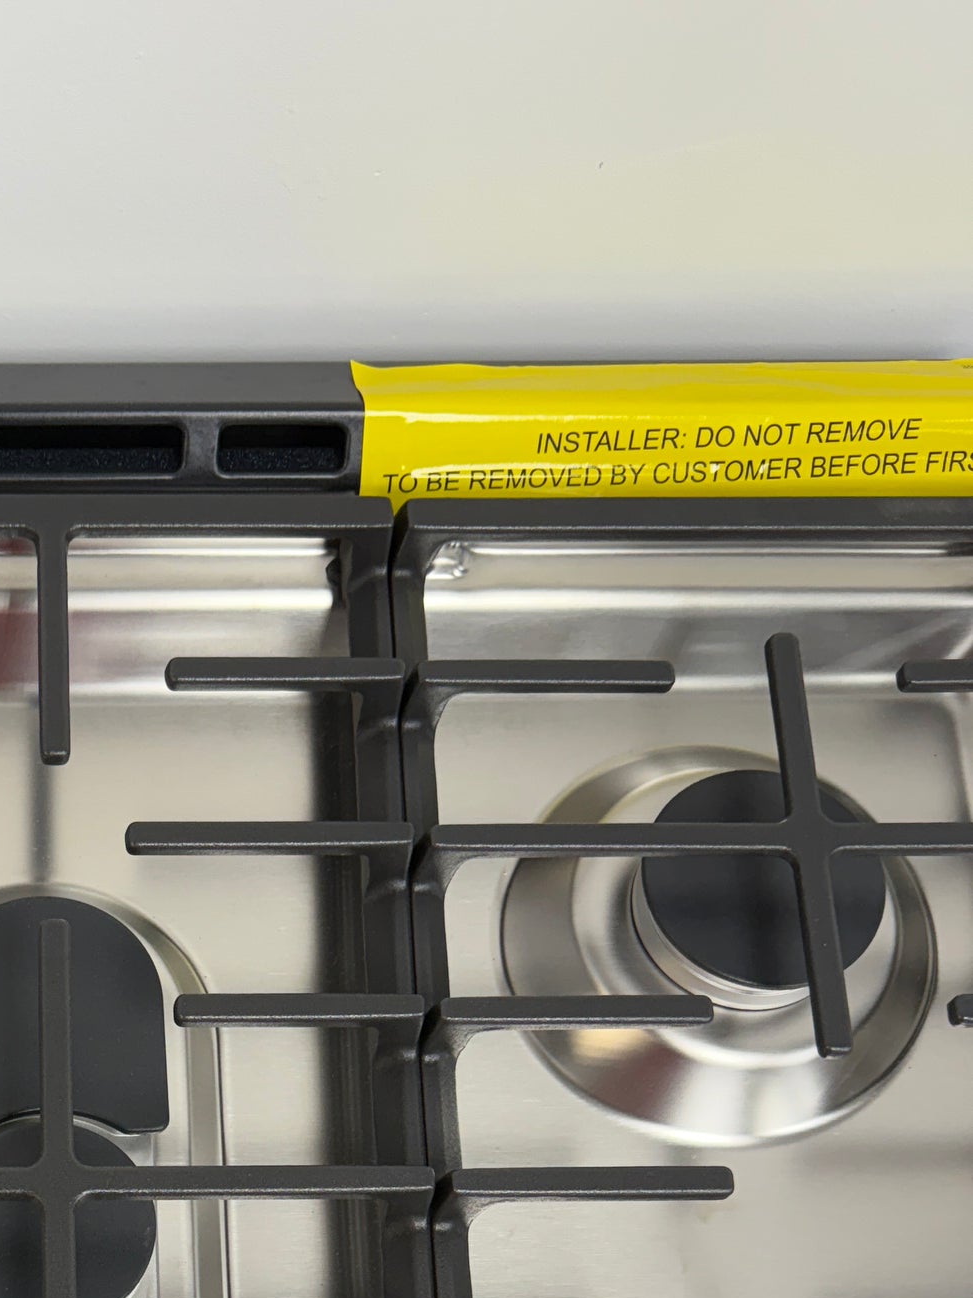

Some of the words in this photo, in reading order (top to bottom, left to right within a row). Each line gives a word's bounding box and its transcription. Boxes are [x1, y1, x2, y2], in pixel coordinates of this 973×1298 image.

[537, 429, 688, 454] INSTALLER:
[695, 426, 735, 448] DO
[743, 424, 801, 446] NOT
[806, 418, 922, 444] REMOVE
[383, 471, 418, 495] TO
[425, 471, 460, 493] BE
[467, 466, 603, 491] REMOVED
[610, 464, 645, 486] BY
[653, 457, 802, 484] CUSTOMER
[810, 453, 918, 479] BEFORE
